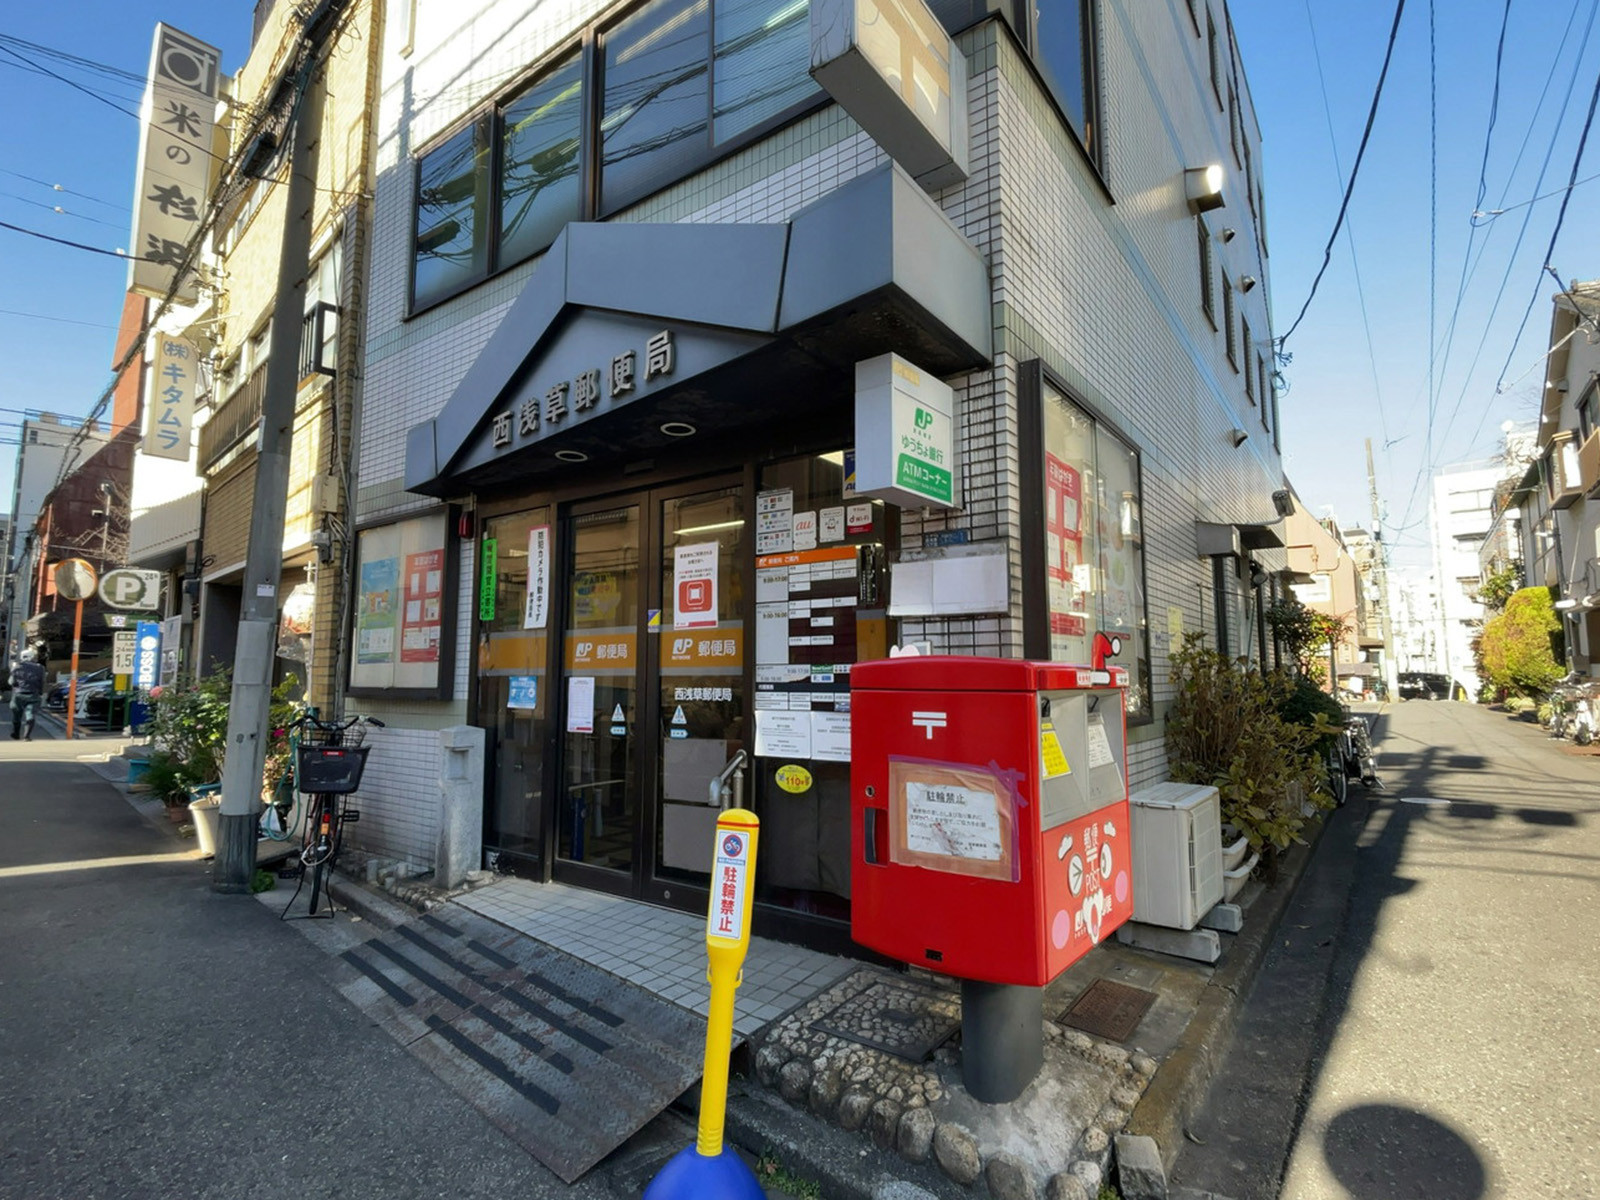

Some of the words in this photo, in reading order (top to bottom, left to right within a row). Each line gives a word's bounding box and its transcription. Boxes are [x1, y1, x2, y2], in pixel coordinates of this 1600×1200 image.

[492, 329, 675, 449] 西浅草郵便局
[914, 407, 933, 430] JP
[902, 434, 943, 465] ゆうちょ銀行
[902, 461, 947, 485] ATMコーナー
[116, 577, 141, 601] P
[576, 643, 593, 657] JP
[596, 643, 628, 660] 郵便局
[672, 638, 693, 655] JP
[698, 639, 736, 657] 郵便局
[138, 650, 155, 683] BOSS
[674, 687, 733, 701] 西浅草郵便局
[926, 790, 966, 805] 駐輪禁止
[718, 866, 737, 933] 駐輪禁止
